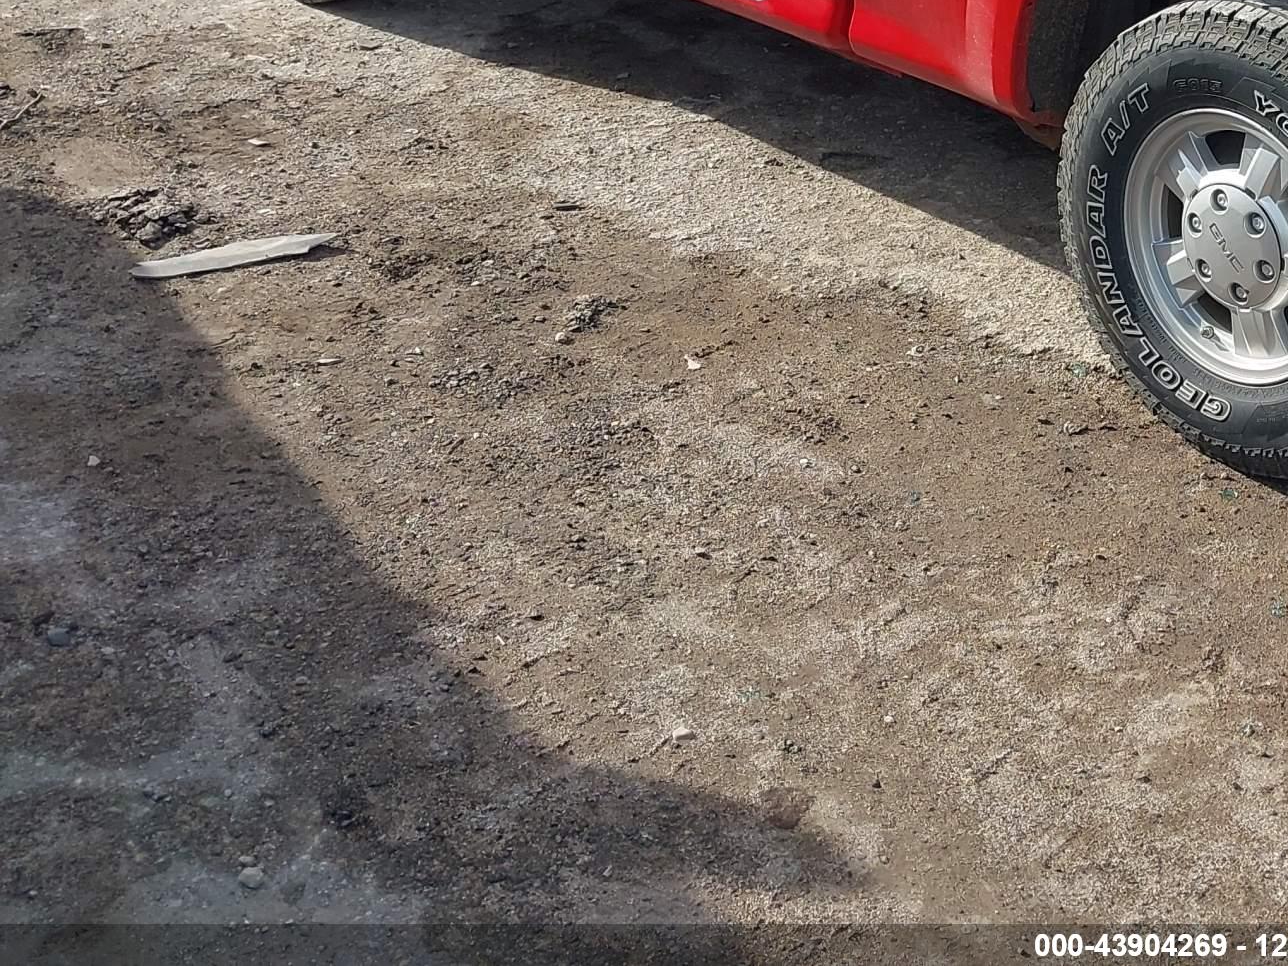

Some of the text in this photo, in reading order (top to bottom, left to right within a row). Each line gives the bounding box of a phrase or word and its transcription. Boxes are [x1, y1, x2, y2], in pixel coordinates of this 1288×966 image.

[1101, 82, 1151, 156] A/T
[1209, 222, 1245, 274] GMC
[1085, 165, 1233, 422] GEOLANDAR
